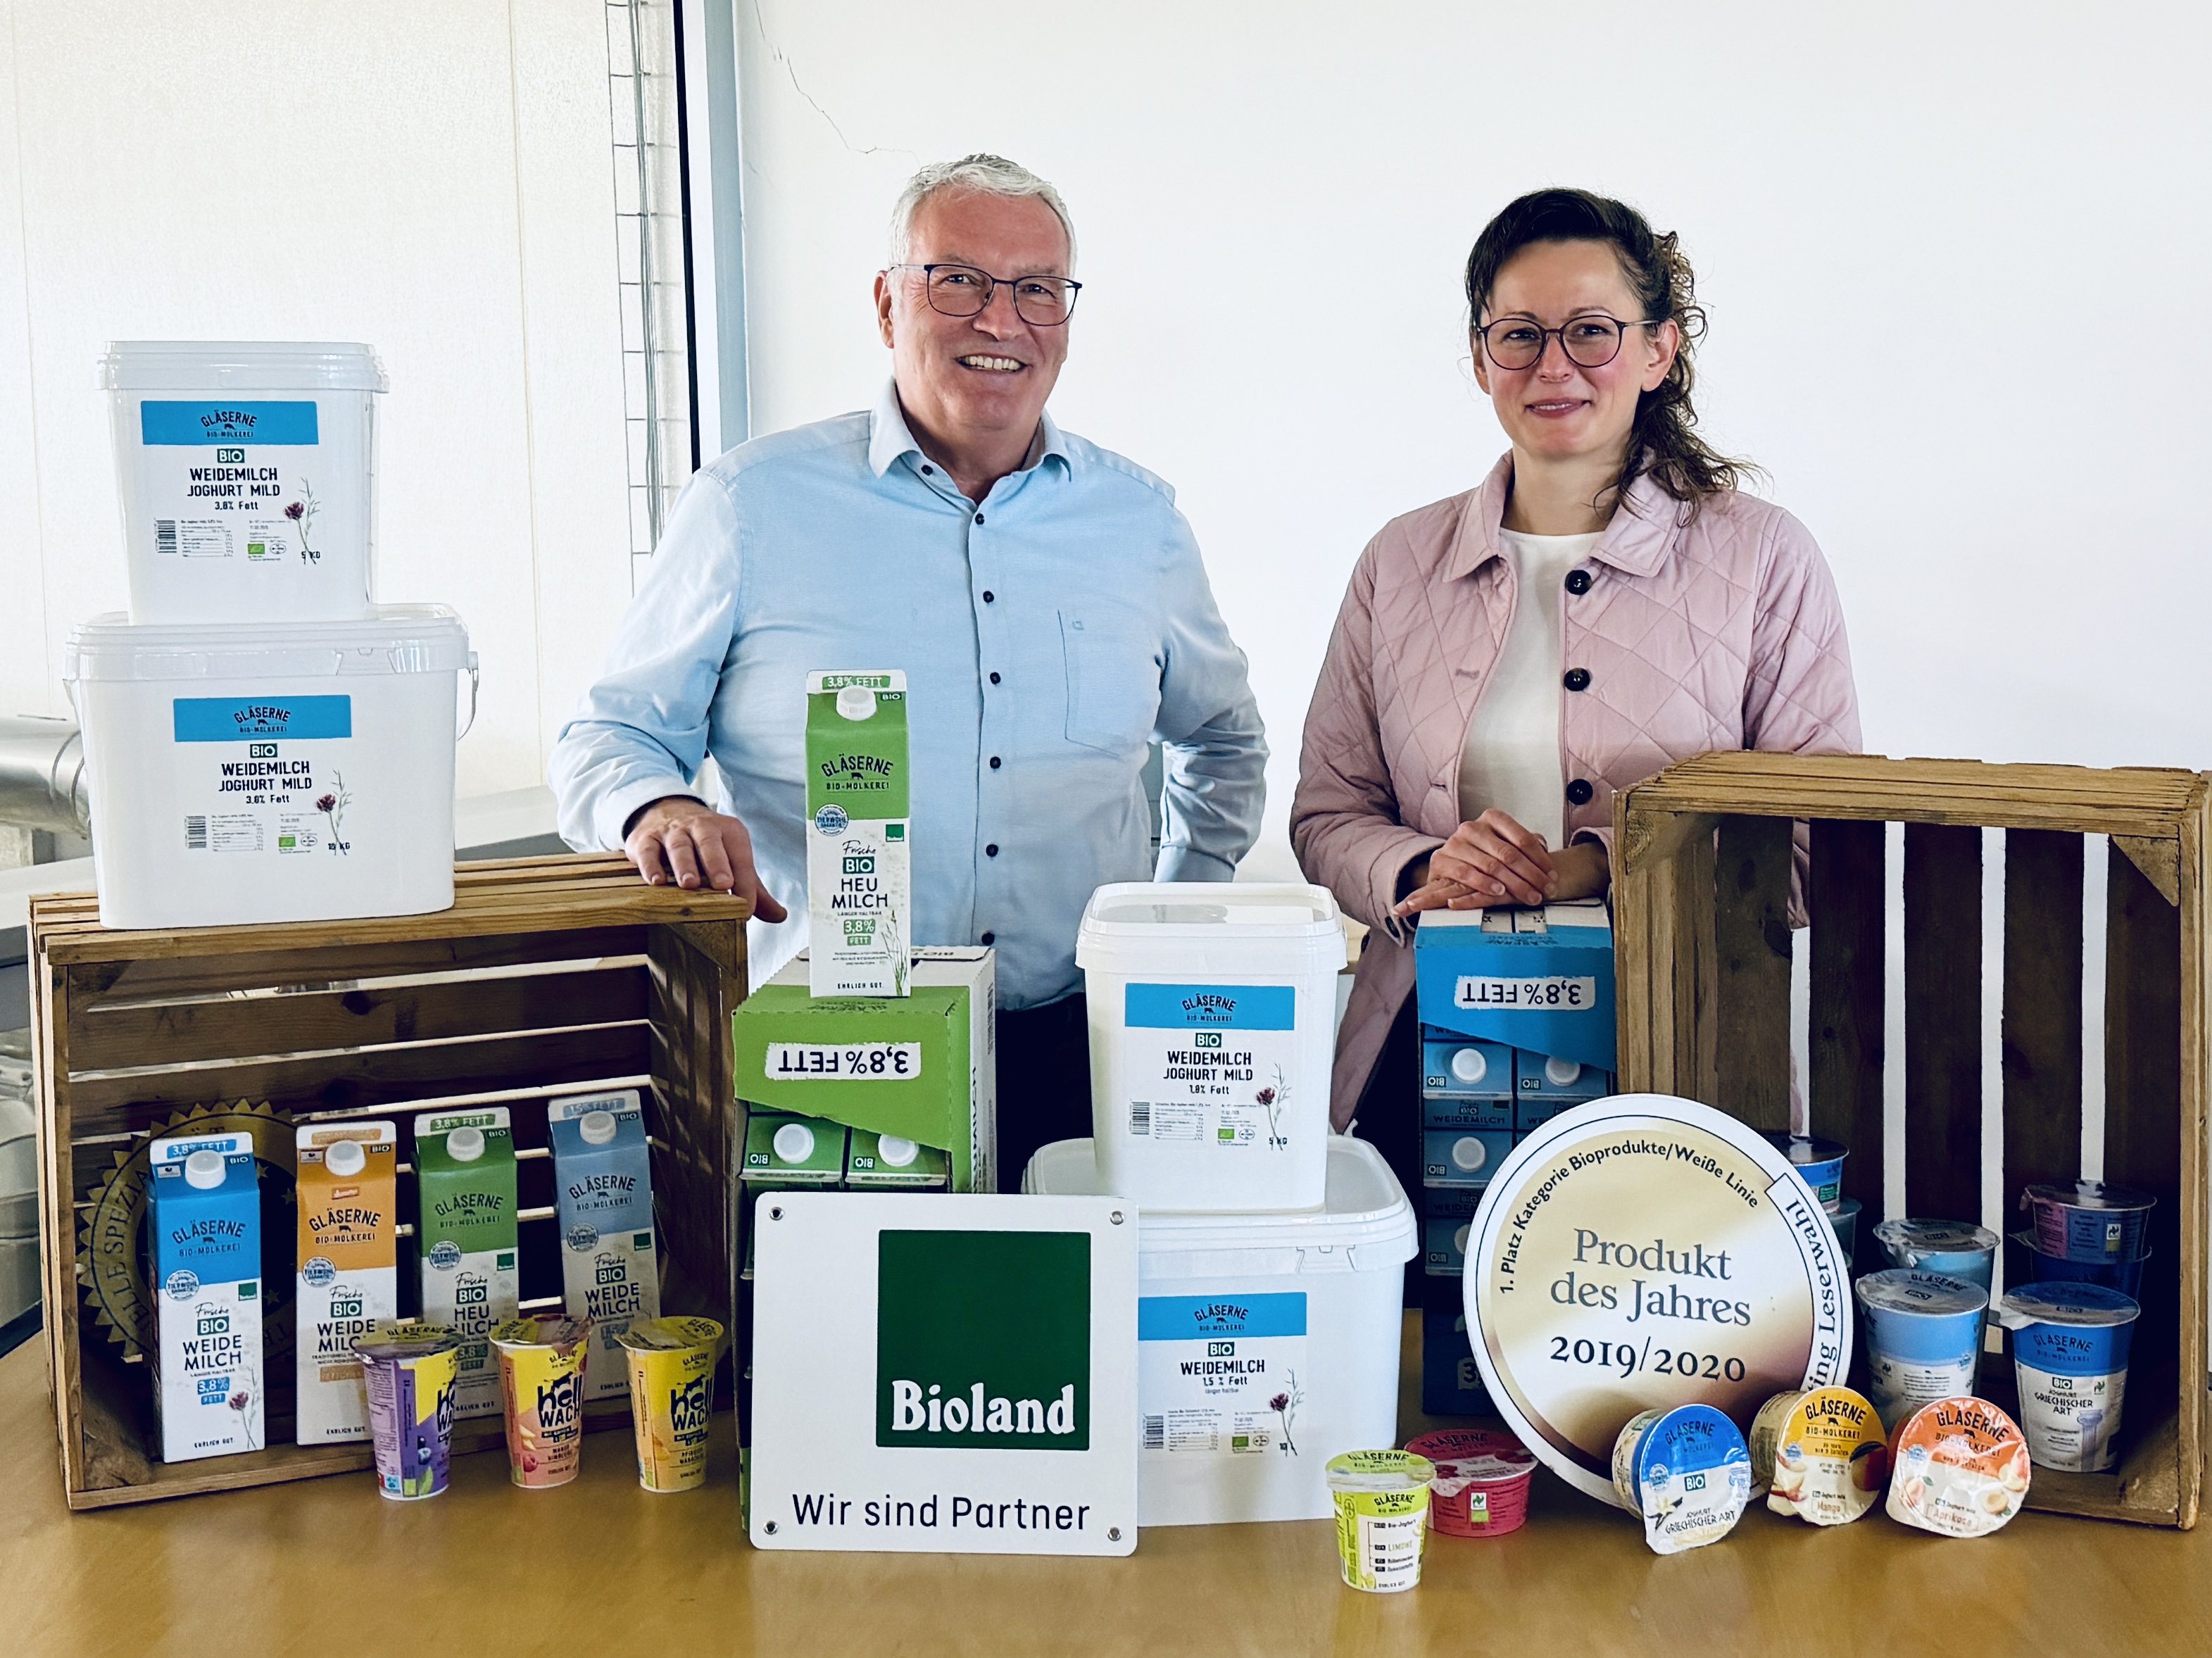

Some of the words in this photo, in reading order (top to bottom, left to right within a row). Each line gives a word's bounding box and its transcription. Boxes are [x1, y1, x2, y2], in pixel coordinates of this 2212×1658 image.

[201, 409, 257, 427] GLÄSERNE
[219, 450, 243, 462] BIO
[189, 467, 277, 481] WEIDEMILCH
[187, 484, 243, 497] JOGHURT
[251, 484, 279, 497] MILD
[239, 501, 258, 510] Fett
[856, 677, 882, 687] FETT
[234, 705, 291, 723] GLÄSERNE
[252, 745, 275, 757] BIO
[221, 760, 310, 777] WEIDEMILCH
[822, 753, 894, 777] GLÄSERNE
[218, 779, 275, 792] JOGHURT
[282, 777, 312, 789] MILD
[826, 781, 889, 791] BIO-MOLKEREI
[270, 794, 289, 803] Fett
[843, 839, 876, 855] Frische
[846, 859, 872, 872] BIO
[841, 878, 877, 892] HEU
[832, 893, 888, 909] MILCH
[845, 920, 874, 934] 3,8%
[1463, 984, 1518, 1003] FETT
[1524, 980, 1581, 1005] 3,8%
[1182, 993, 1236, 1012] GLÄSERNE
[1198, 1034, 1219, 1046] BIO
[778, 1050, 838, 1072] FETT
[846, 1047, 908, 1074] 3,8%
[1167, 1050, 1252, 1065] WEIDEMILCH
[1163, 1068, 1217, 1081] JOGHURT
[1224, 1069, 1252, 1081] MILD
[1428, 1077, 1445, 1086] BIO
[1211, 1085, 1229, 1095] Fett
[1523, 1080, 1540, 1089] BIO
[463, 1116, 488, 1126] FETT
[1433, 1114, 1505, 1124] WEIDEMILCH
[750, 1153, 768, 1164] BIO
[855, 1157, 874, 1169] BIO
[1569, 1140, 1723, 1179] Bioprodukte/Weiße
[1429, 1166, 1445, 1175] BIO
[570, 1175, 636, 1200] GLÄSERNE
[1726, 1171, 1759, 1209] Linie
[435, 1193, 504, 1216] GLÄSERNE
[577, 1196, 632, 1211] BIO-MOLKEREI
[1514, 1166, 1570, 1231] Kategorie
[309, 1207, 381, 1231] GLÄSERNE
[172, 1219, 246, 1244] GLÄSERNE
[315, 1233, 375, 1243] BIO-MOLKEREI
[180, 1244, 240, 1257] BIO-MOLKEREI
[1430, 1253, 1447, 1262] BIO
[1501, 1232, 1523, 1274] Platz
[1572, 1229, 1731, 1281] Produkt
[594, 1252, 625, 1267] Frische
[1785, 1198, 1837, 1335] Leserwahl
[455, 1271, 488, 1287] Frische
[599, 1268, 624, 1283] BIO
[329, 1285, 363, 1300] Frische
[584, 1282, 640, 1304] WEIDE
[1500, 1276, 1515, 1294] 1.
[459, 1288, 484, 1302] BIO
[1551, 1271, 1618, 1310] des
[1627, 1279, 1752, 1326] Jahres
[195, 1302, 229, 1317] Frische
[334, 1302, 360, 1316] BIO
[454, 1305, 489, 1321] HEU
[588, 1297, 640, 1318] MILCH
[1195, 1303, 1249, 1321] GLÄSERNE
[200, 1319, 227, 1333] BIO
[318, 1319, 375, 1336] WEIDE
[454, 1319, 499, 1336] ILCH
[183, 1335, 242, 1355] WEIDE
[318, 1336, 363, 1352] MILC
[1210, 1343, 1232, 1355] BIO
[184, 1351, 241, 1371] MILCH
[1181, 1359, 1265, 1375] WEIDEMILCH
[1550, 1336, 1746, 1383] 2019/2020
[198, 1378, 229, 1393] 3,8%
[1229, 1376, 1248, 1385] Fett
[2054, 1378, 2070, 1388] BIO
[537, 1374, 583, 1412] hell
[2035, 1392, 2094, 1408] GRIECHISCHER
[891, 1379, 1075, 1434] Bioland
[1805, 1396, 1867, 1426] GLÄSERNE
[2054, 1407, 2072, 1416] ART
[540, 1405, 581, 1428] WACH
[1806, 1426, 1861, 1439] BIO-MOLKEREI
[1686, 1476, 1704, 1490] BIO
[793, 1493, 851, 1525] Wir
[865, 1494, 938, 1528] sind
[953, 1496, 1090, 1530] Partner
[1665, 1516, 1717, 1533] GRIECHISCHER
[1719, 1511, 1736, 1521] ART
